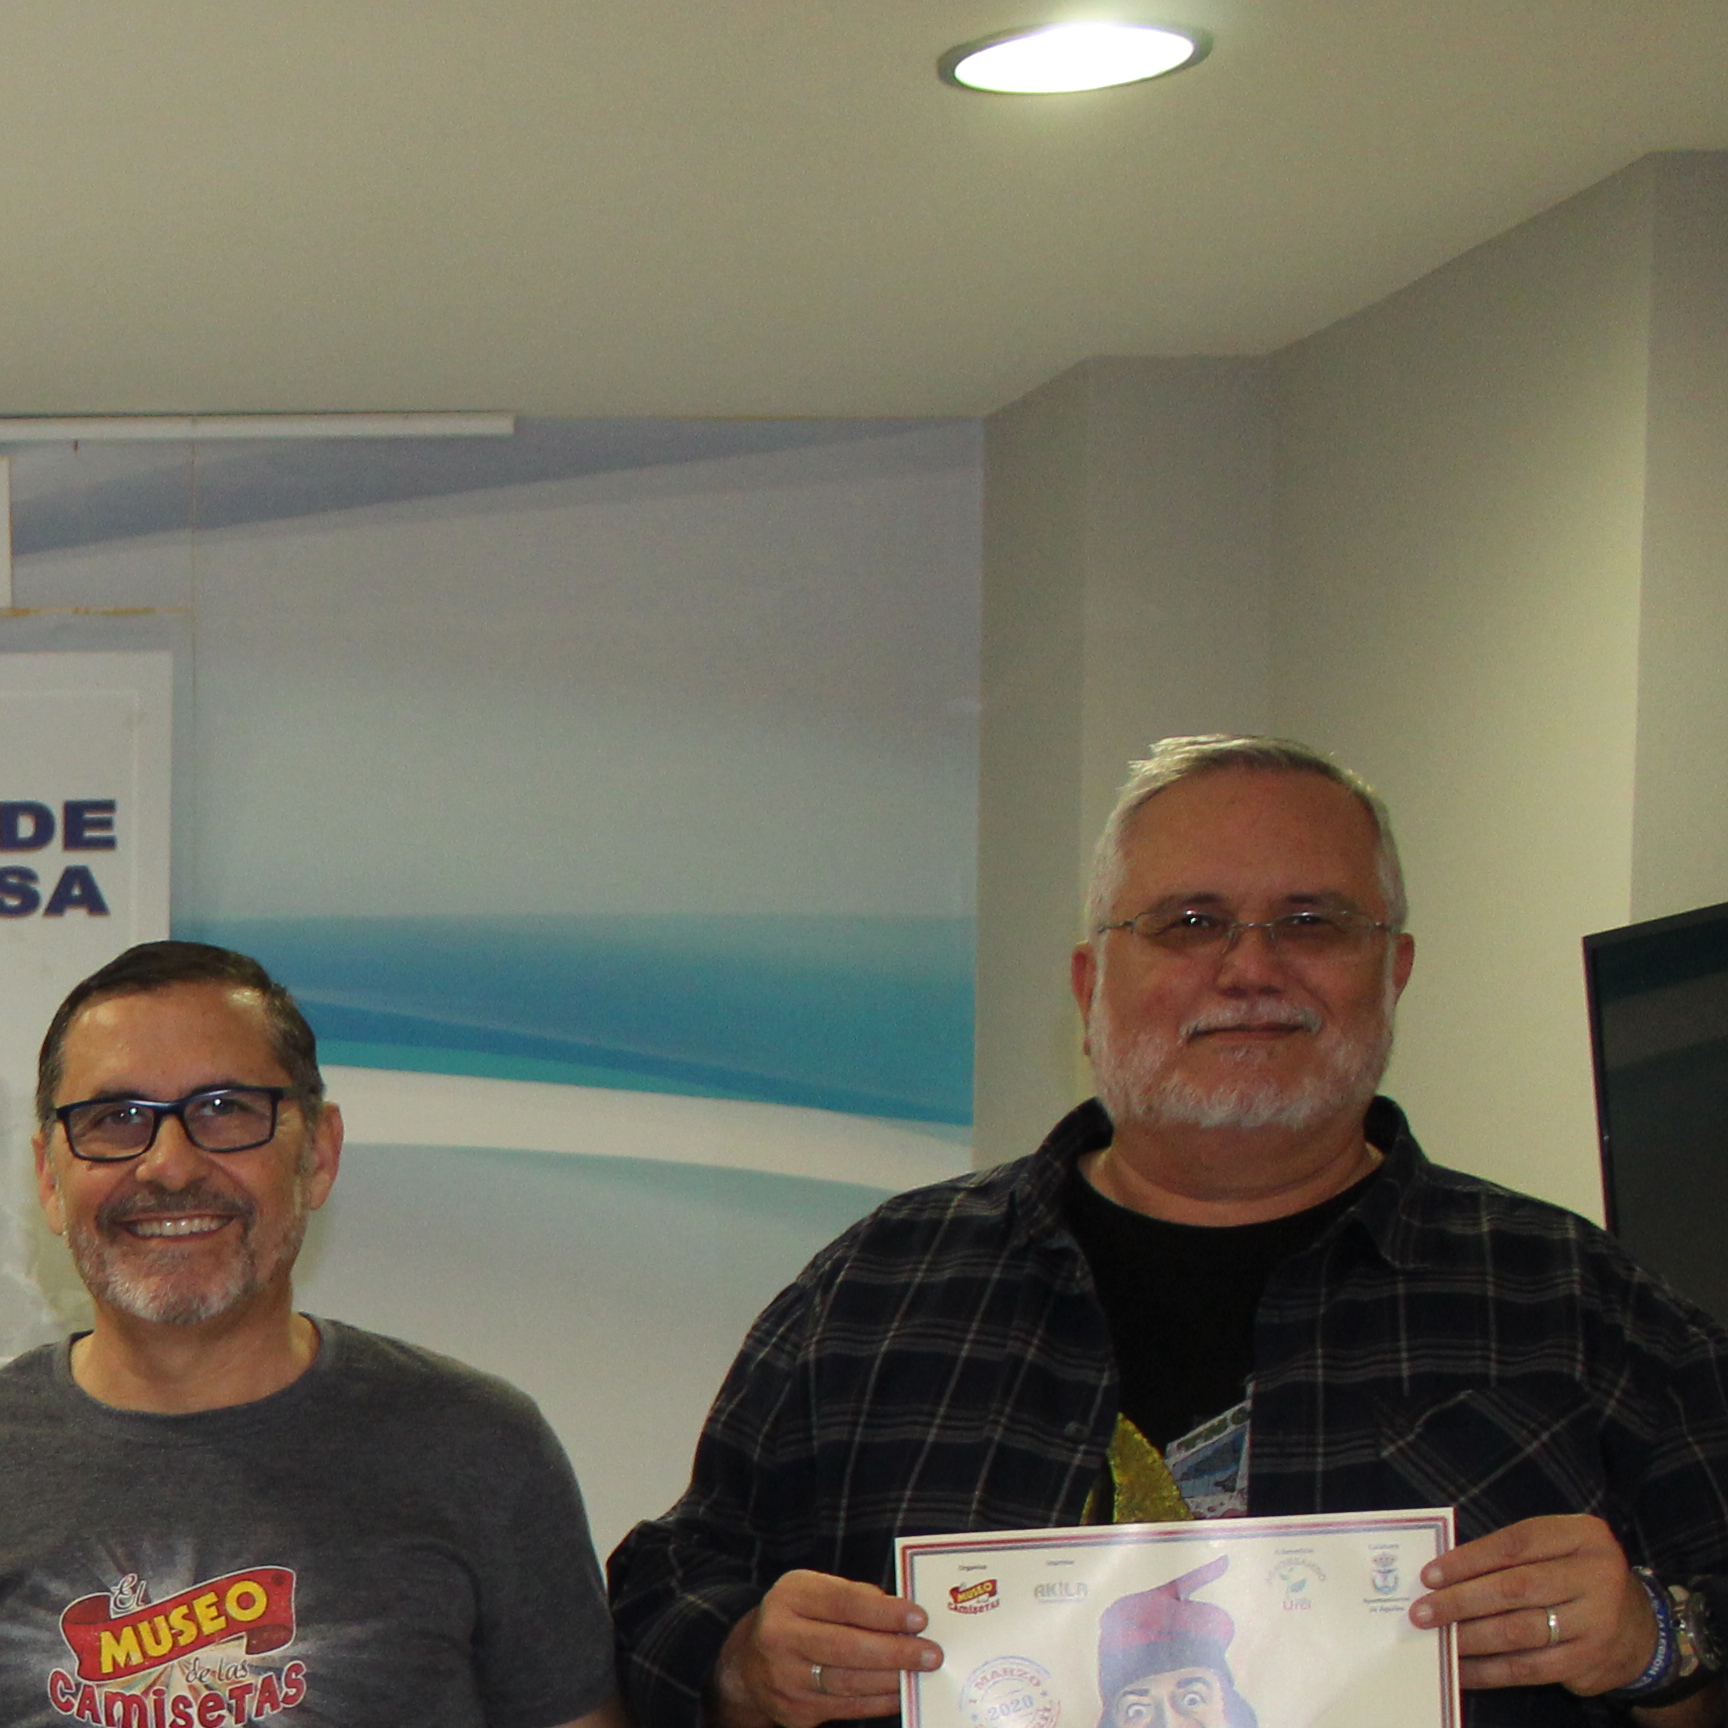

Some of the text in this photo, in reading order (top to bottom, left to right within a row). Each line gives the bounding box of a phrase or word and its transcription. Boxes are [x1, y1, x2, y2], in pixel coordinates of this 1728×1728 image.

[111, 1573, 146, 1613] El
[100, 1580, 268, 1674] MUSEO
[185, 1656, 250, 1684] de las
[987, 1695, 1034, 1721] 2020
